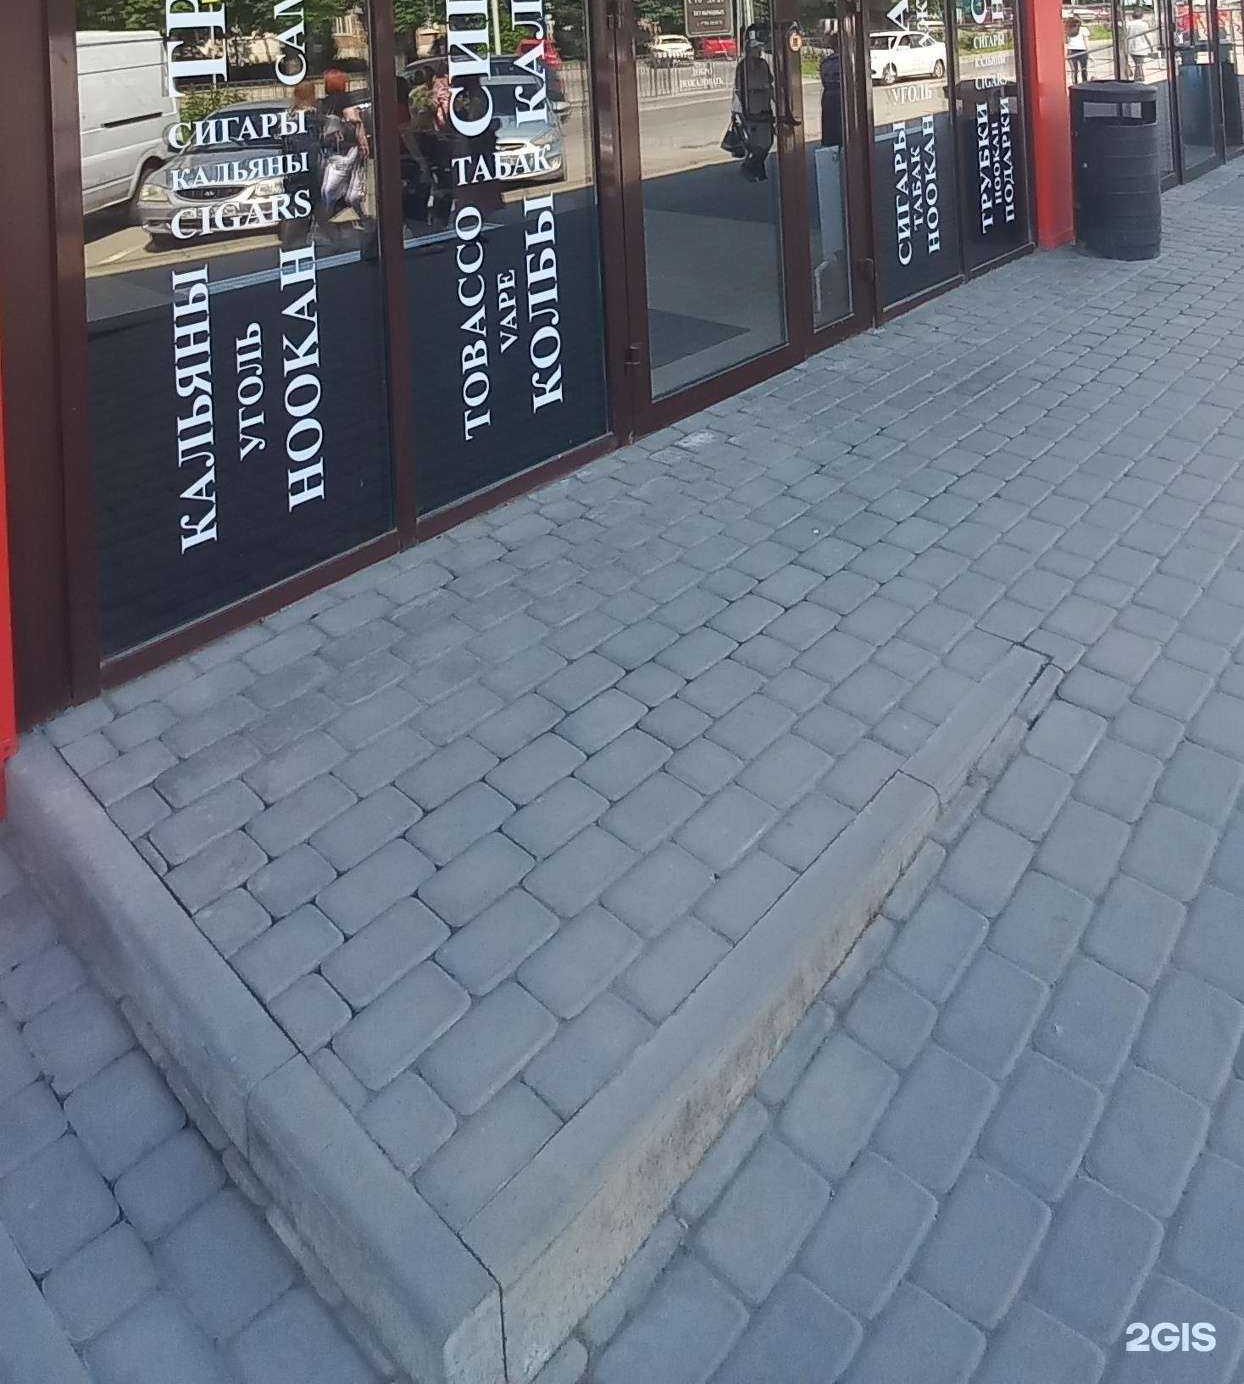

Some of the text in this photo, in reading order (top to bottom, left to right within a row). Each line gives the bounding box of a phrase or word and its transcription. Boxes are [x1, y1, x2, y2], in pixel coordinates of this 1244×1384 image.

[167, 109, 308, 150] СИГАРЫ
[171, 151, 309, 193] КАЛЬЯНЫ
[451, 143, 551, 187] ТАБАК
[892, 121, 913, 266] СИГАРЫ
[910, 144, 925, 231] ТАБАК
[975, 101, 994, 235] ТРУБКИ
[1000, 96, 1016, 224] ПОДАРКИ
[170, 188, 313, 240] CIGARS
[454, 205, 491, 441] TOBACCO
[497, 269, 520, 354] VAPE
[524, 191, 564, 414] КОЛБЫ
[171, 263, 218, 555] КАЛЬЯНЫ
[235, 321, 266, 463] УГОЛЬ
[279, 241, 326, 513] HOOKAH
